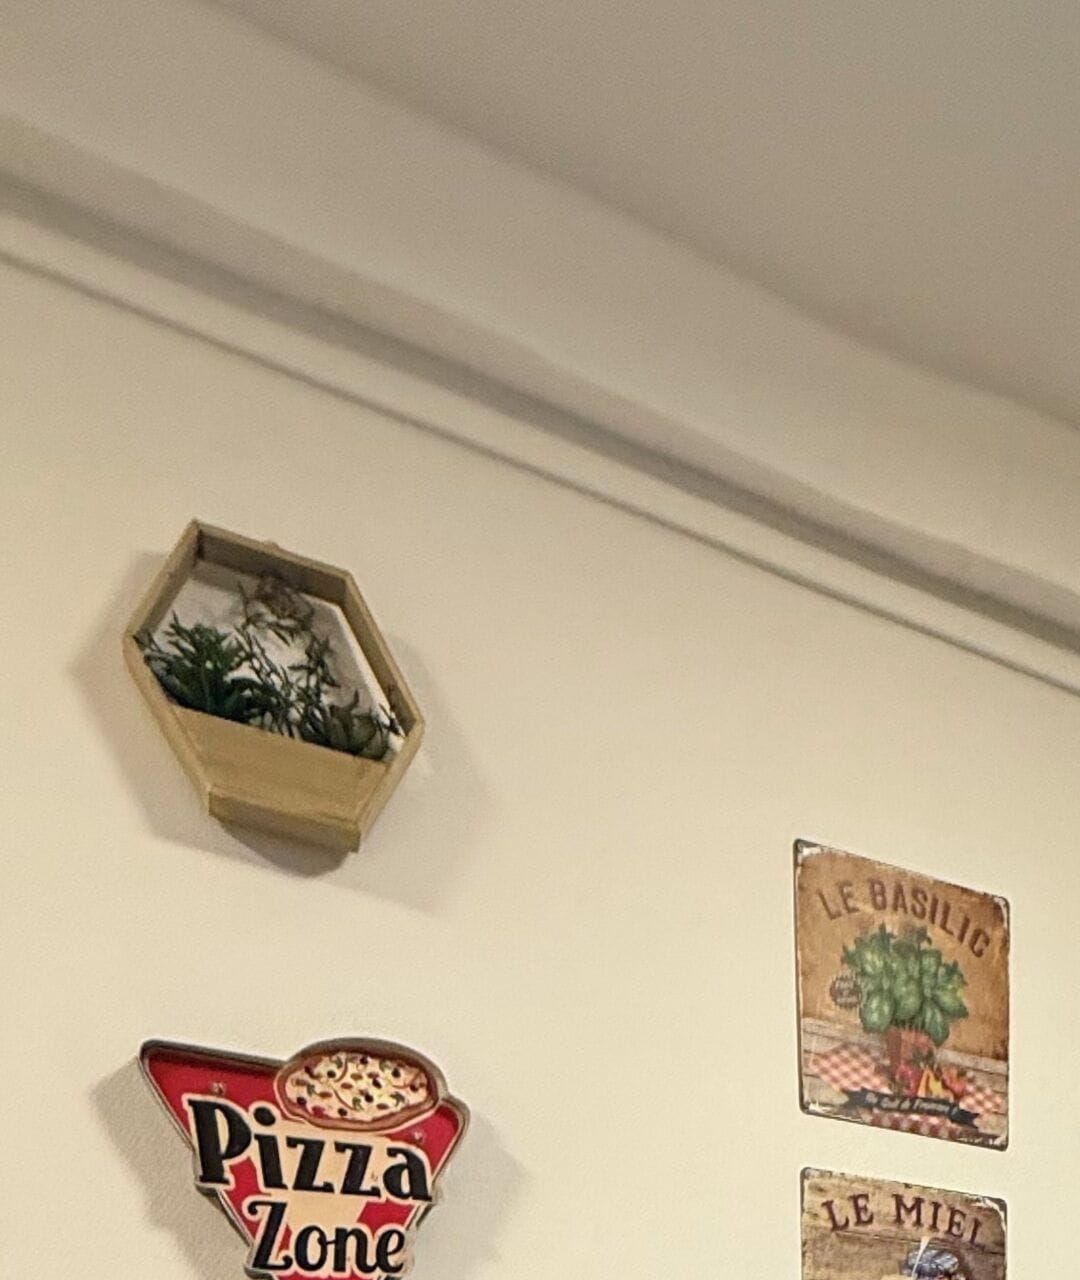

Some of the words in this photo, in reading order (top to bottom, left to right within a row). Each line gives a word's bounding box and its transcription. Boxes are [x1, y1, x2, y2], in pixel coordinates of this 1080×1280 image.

[816, 881, 858, 921] LE
[869, 879, 990, 957] BASILIC
[186, 1097, 433, 1202] Pizza
[247, 1200, 406, 1274] Zone
[821, 1193, 874, 1232] LE
